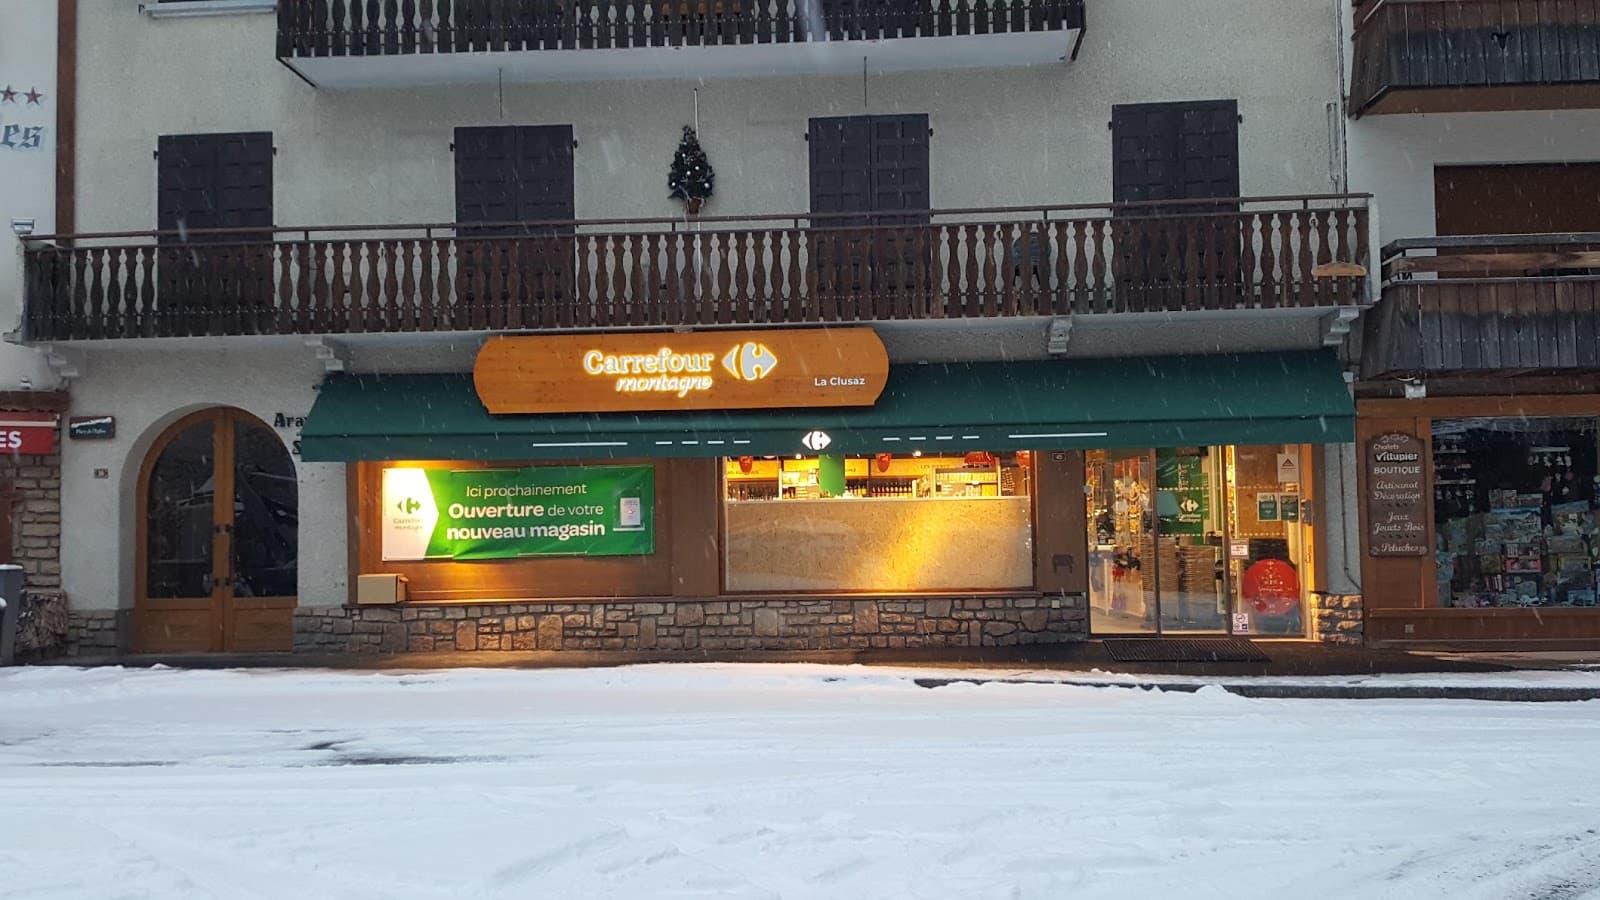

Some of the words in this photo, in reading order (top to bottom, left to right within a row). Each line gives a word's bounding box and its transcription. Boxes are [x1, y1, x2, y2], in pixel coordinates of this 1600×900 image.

[584, 348, 715, 374] Carrefour
[616, 374, 713, 398] montagne
[814, 377, 828, 386] La
[830, 376, 866, 387] Clusaz
[1374, 466, 1421, 475] BOUTIQUE
[466, 485, 482, 497] Ici
[484, 483, 588, 499] prochainement
[448, 503, 545, 519] Ouverture
[547, 504, 566, 517] de
[567, 504, 604, 516] votre
[446, 525, 526, 541] nouveau
[529, 520, 606, 542] magasin
